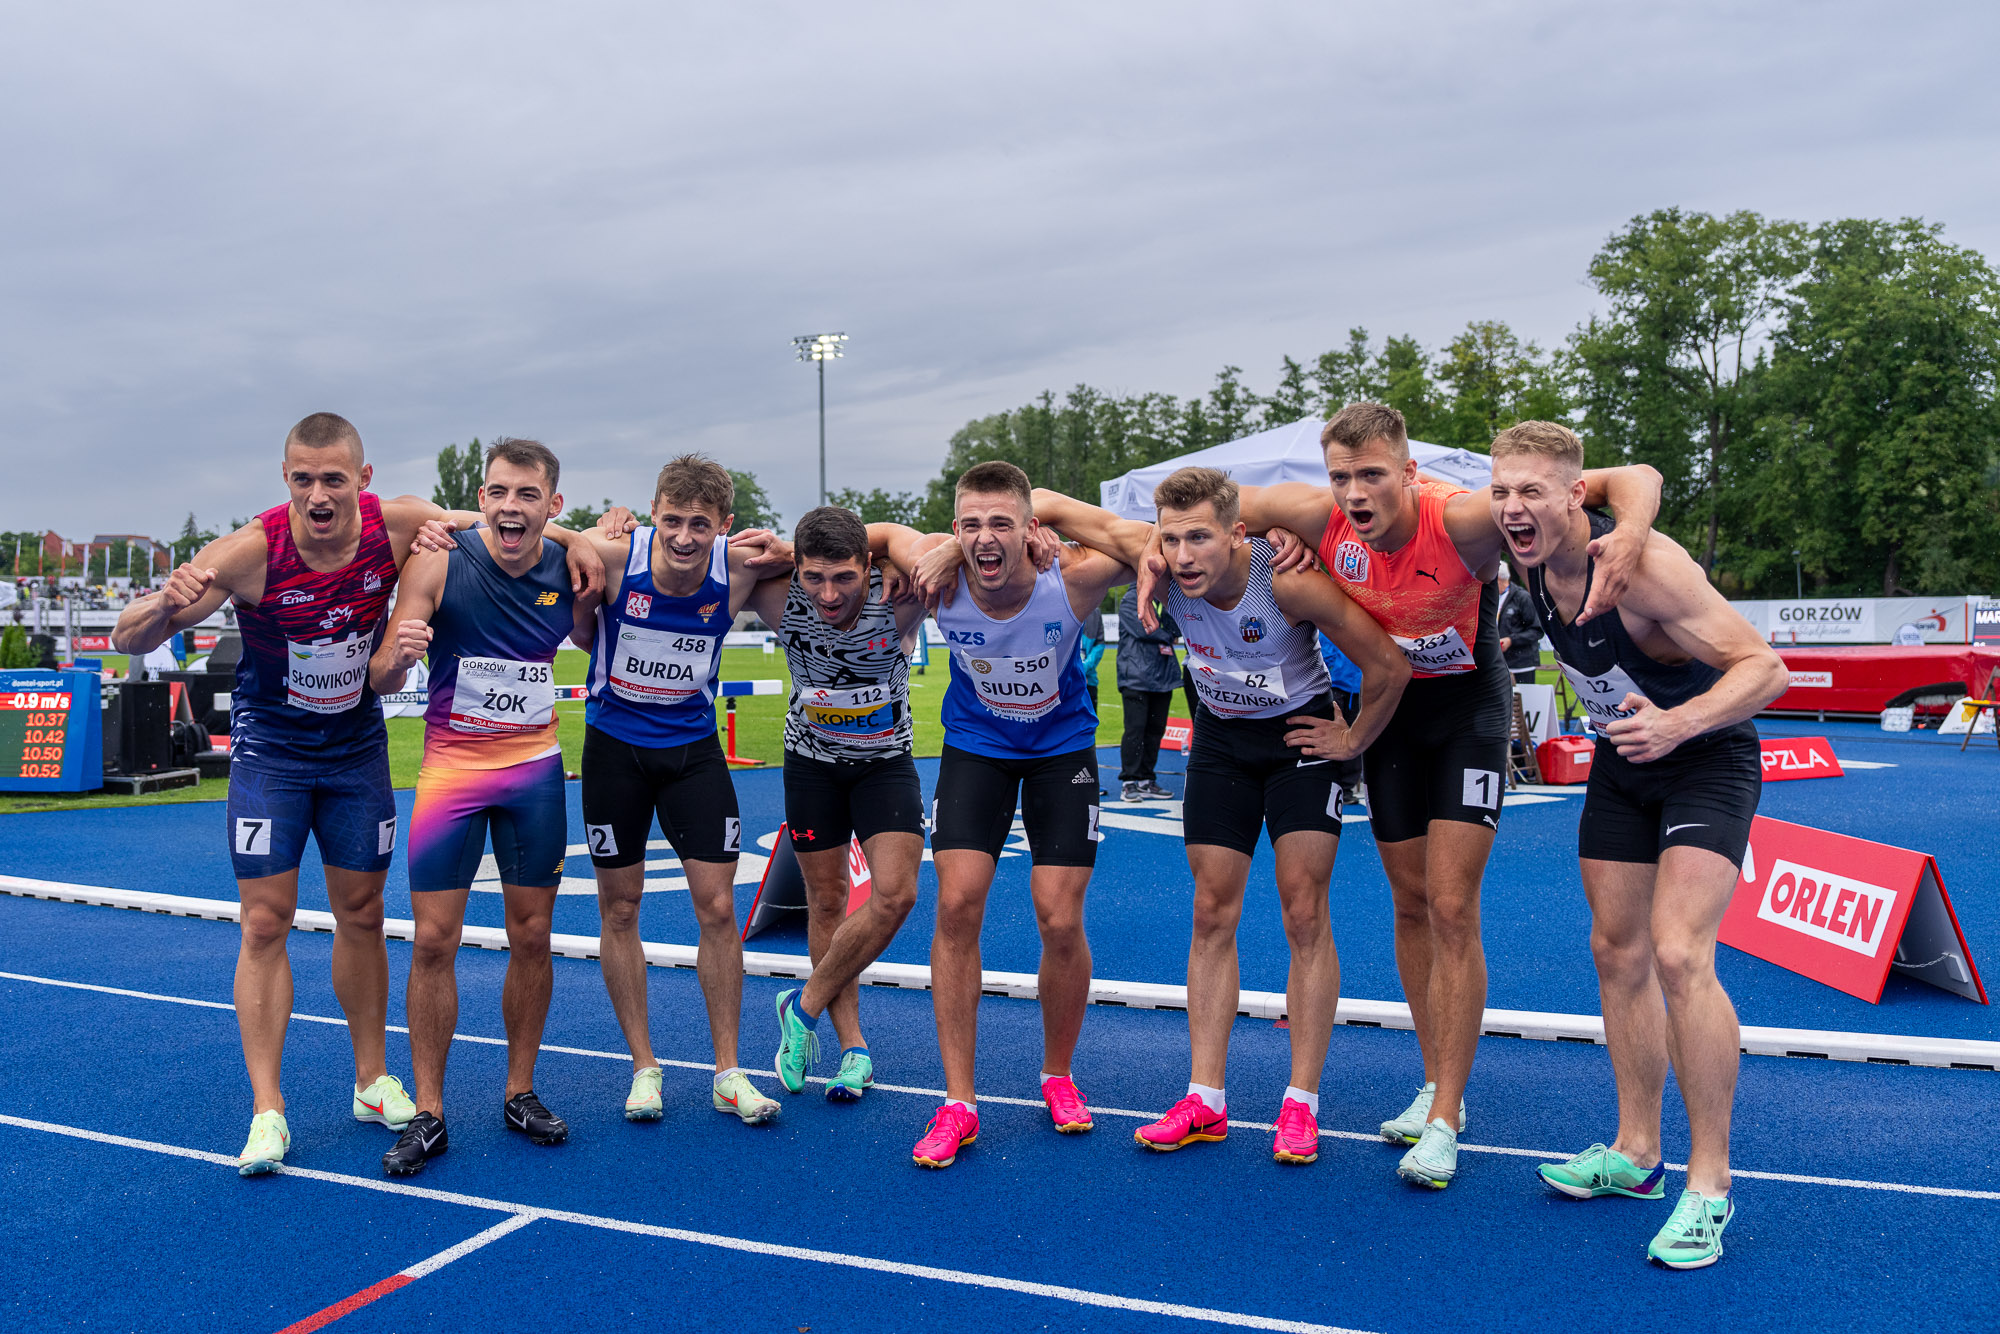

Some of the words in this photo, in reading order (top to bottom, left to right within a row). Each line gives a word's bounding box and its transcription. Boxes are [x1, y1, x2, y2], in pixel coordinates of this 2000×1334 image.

[282, 594, 314, 605] Enea
[1780, 603, 1862, 621] GORZÓW
[672, 637, 706, 653] 458
[948, 631, 985, 646] AZS
[462, 661, 507, 672] GORZÓW
[626, 656, 694, 681] BURDA
[1014, 656, 1049, 673] 550
[517, 666, 547, 683] 135
[1245, 674, 1268, 688] 62
[1790, 674, 1828, 683] polanik
[612, 685, 638, 698] GORZÓW
[640, 693, 681, 702] WIELKOPOLSKI
[981, 681, 1044, 697] SIUDA
[1196, 680, 1285, 707] BRZEZIŃSKI
[1586, 680, 1615, 693] 12
[8, 693, 39, 709] -0.9
[41, 693, 69, 709] m/s
[292, 698, 320, 710] GORZÓW
[482, 688, 528, 714] ŻOK
[851, 688, 883, 706] 112
[1036, 699, 1051, 708] Polski
[25, 713, 67, 727] 10.37
[473, 718, 486, 726] PZLA
[816, 710, 879, 728] KOPEĆ
[23, 730, 65, 744] 10.42
[21, 747, 63, 760] 10.50
[1761, 747, 1830, 771] PZLA
[19, 764, 61, 778] 10.52
[1072, 776, 1095, 784] adidas
[1475, 774, 1490, 804] 1
[243, 821, 263, 851] 7
[385, 820, 396, 850] 7
[592, 828, 610, 854] 2
[1770, 871, 1884, 944] ORLEN
